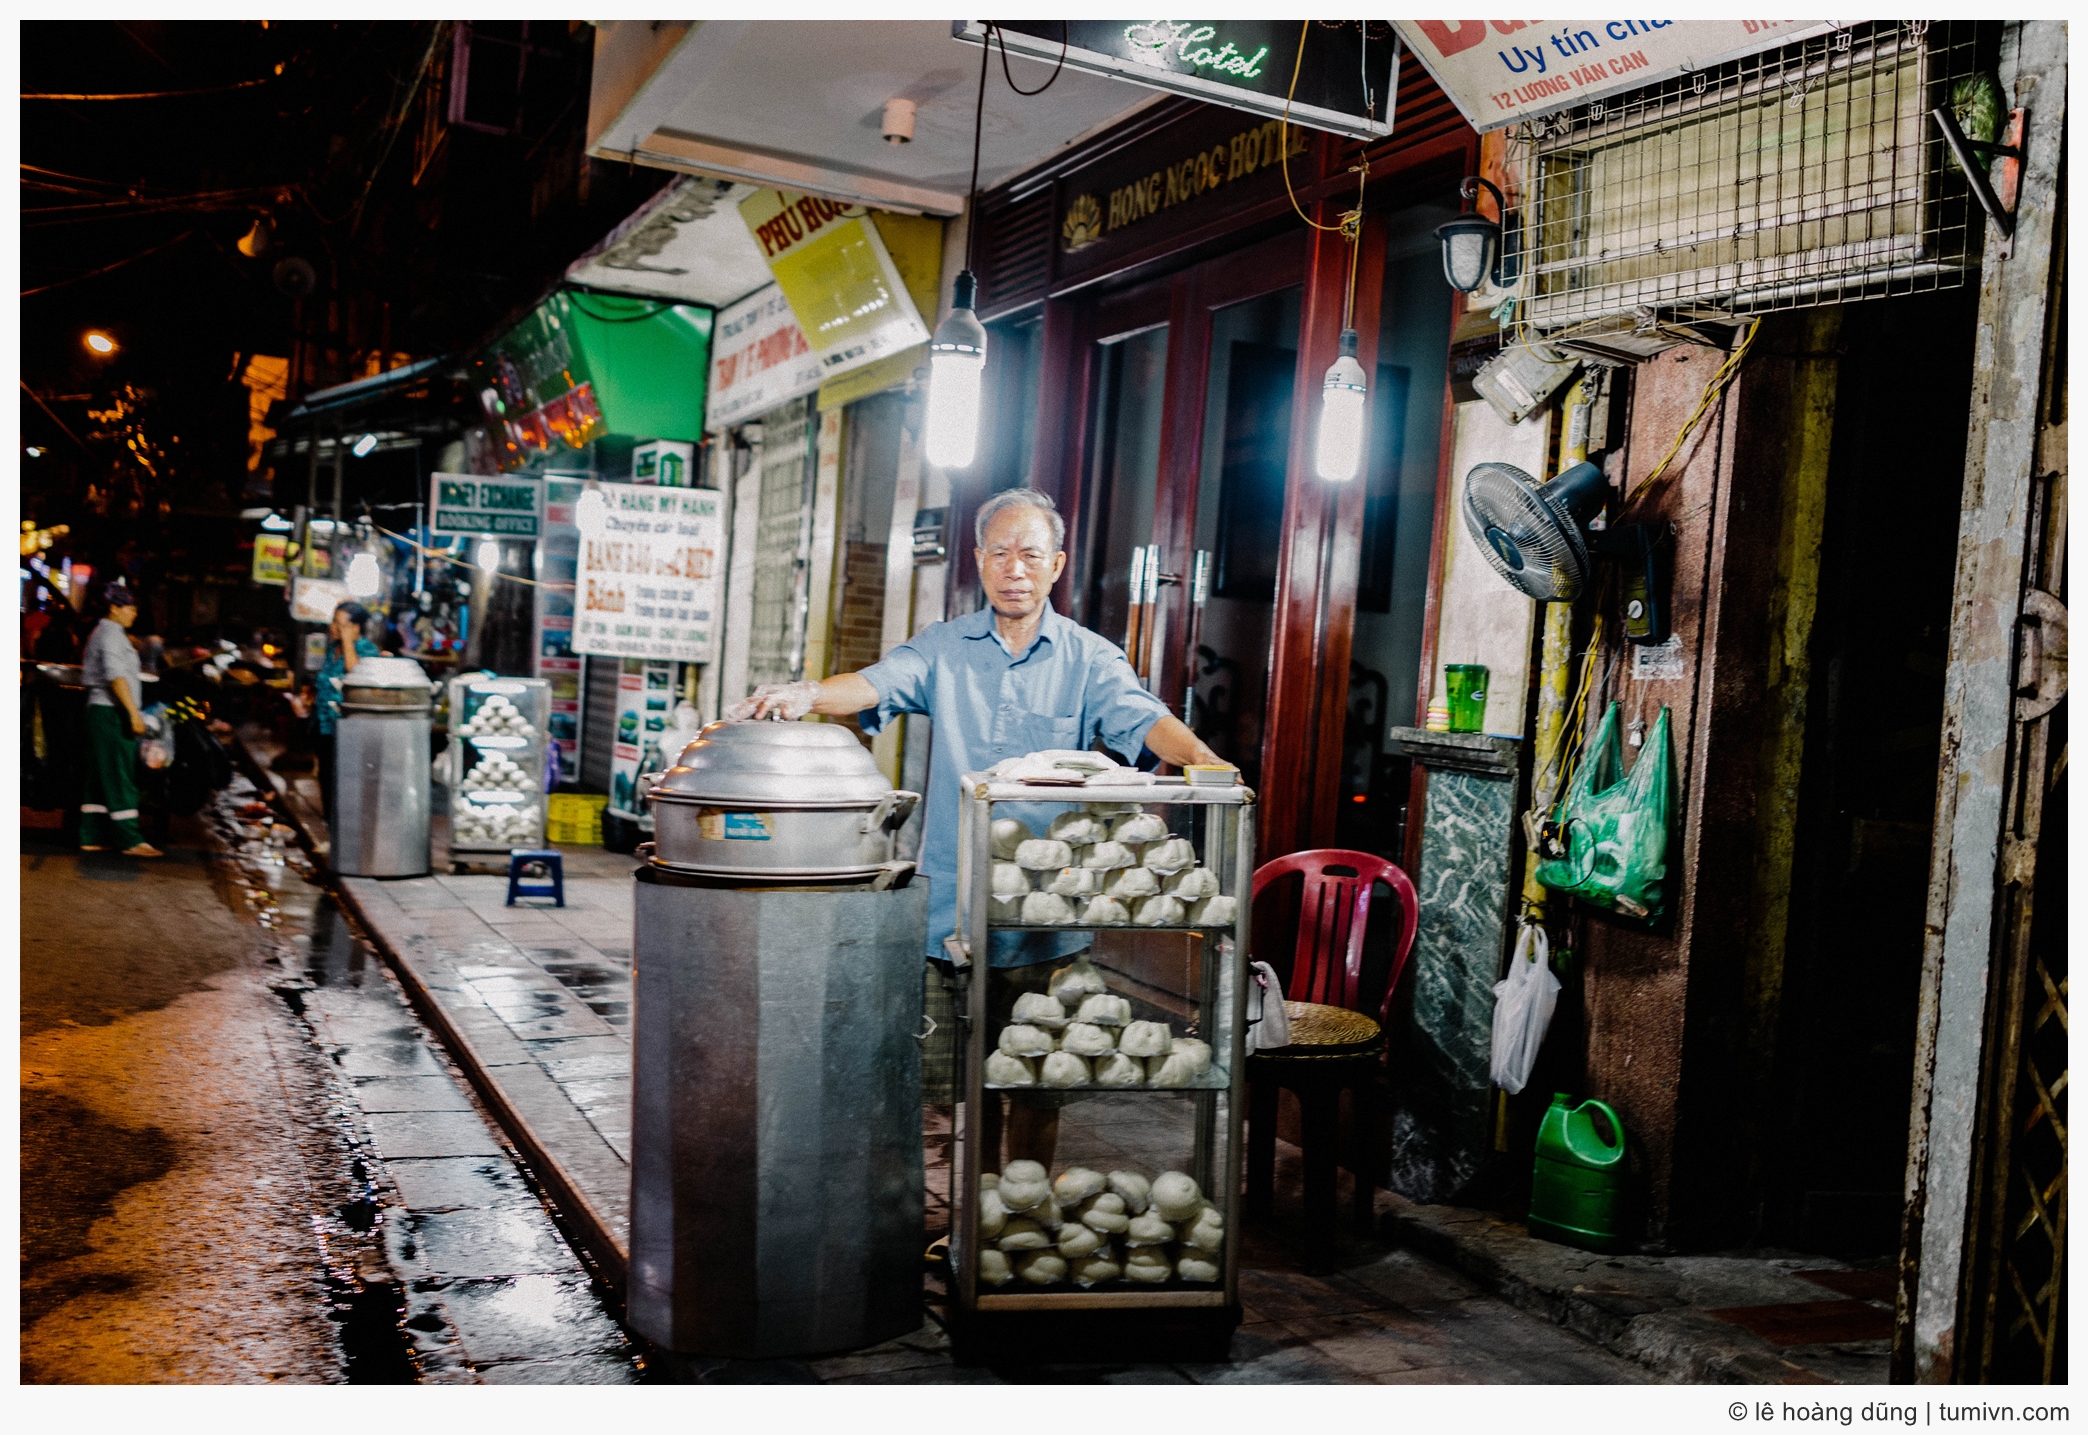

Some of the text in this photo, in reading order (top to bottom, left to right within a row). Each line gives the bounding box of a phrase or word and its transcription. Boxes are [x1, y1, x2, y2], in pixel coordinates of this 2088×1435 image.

[1124, 20, 1268, 78] Hotel
[1498, 45, 1547, 74] Uy
[1551, 27, 1600, 57] tín
[1492, 50, 1650, 110] 12 LƯƠNG VĂN CAN
[1108, 120, 1309, 231] HONG NGOC HOTEL
[756, 191, 803, 257] PHÚ
[494, 517, 533, 532] OFFICE
